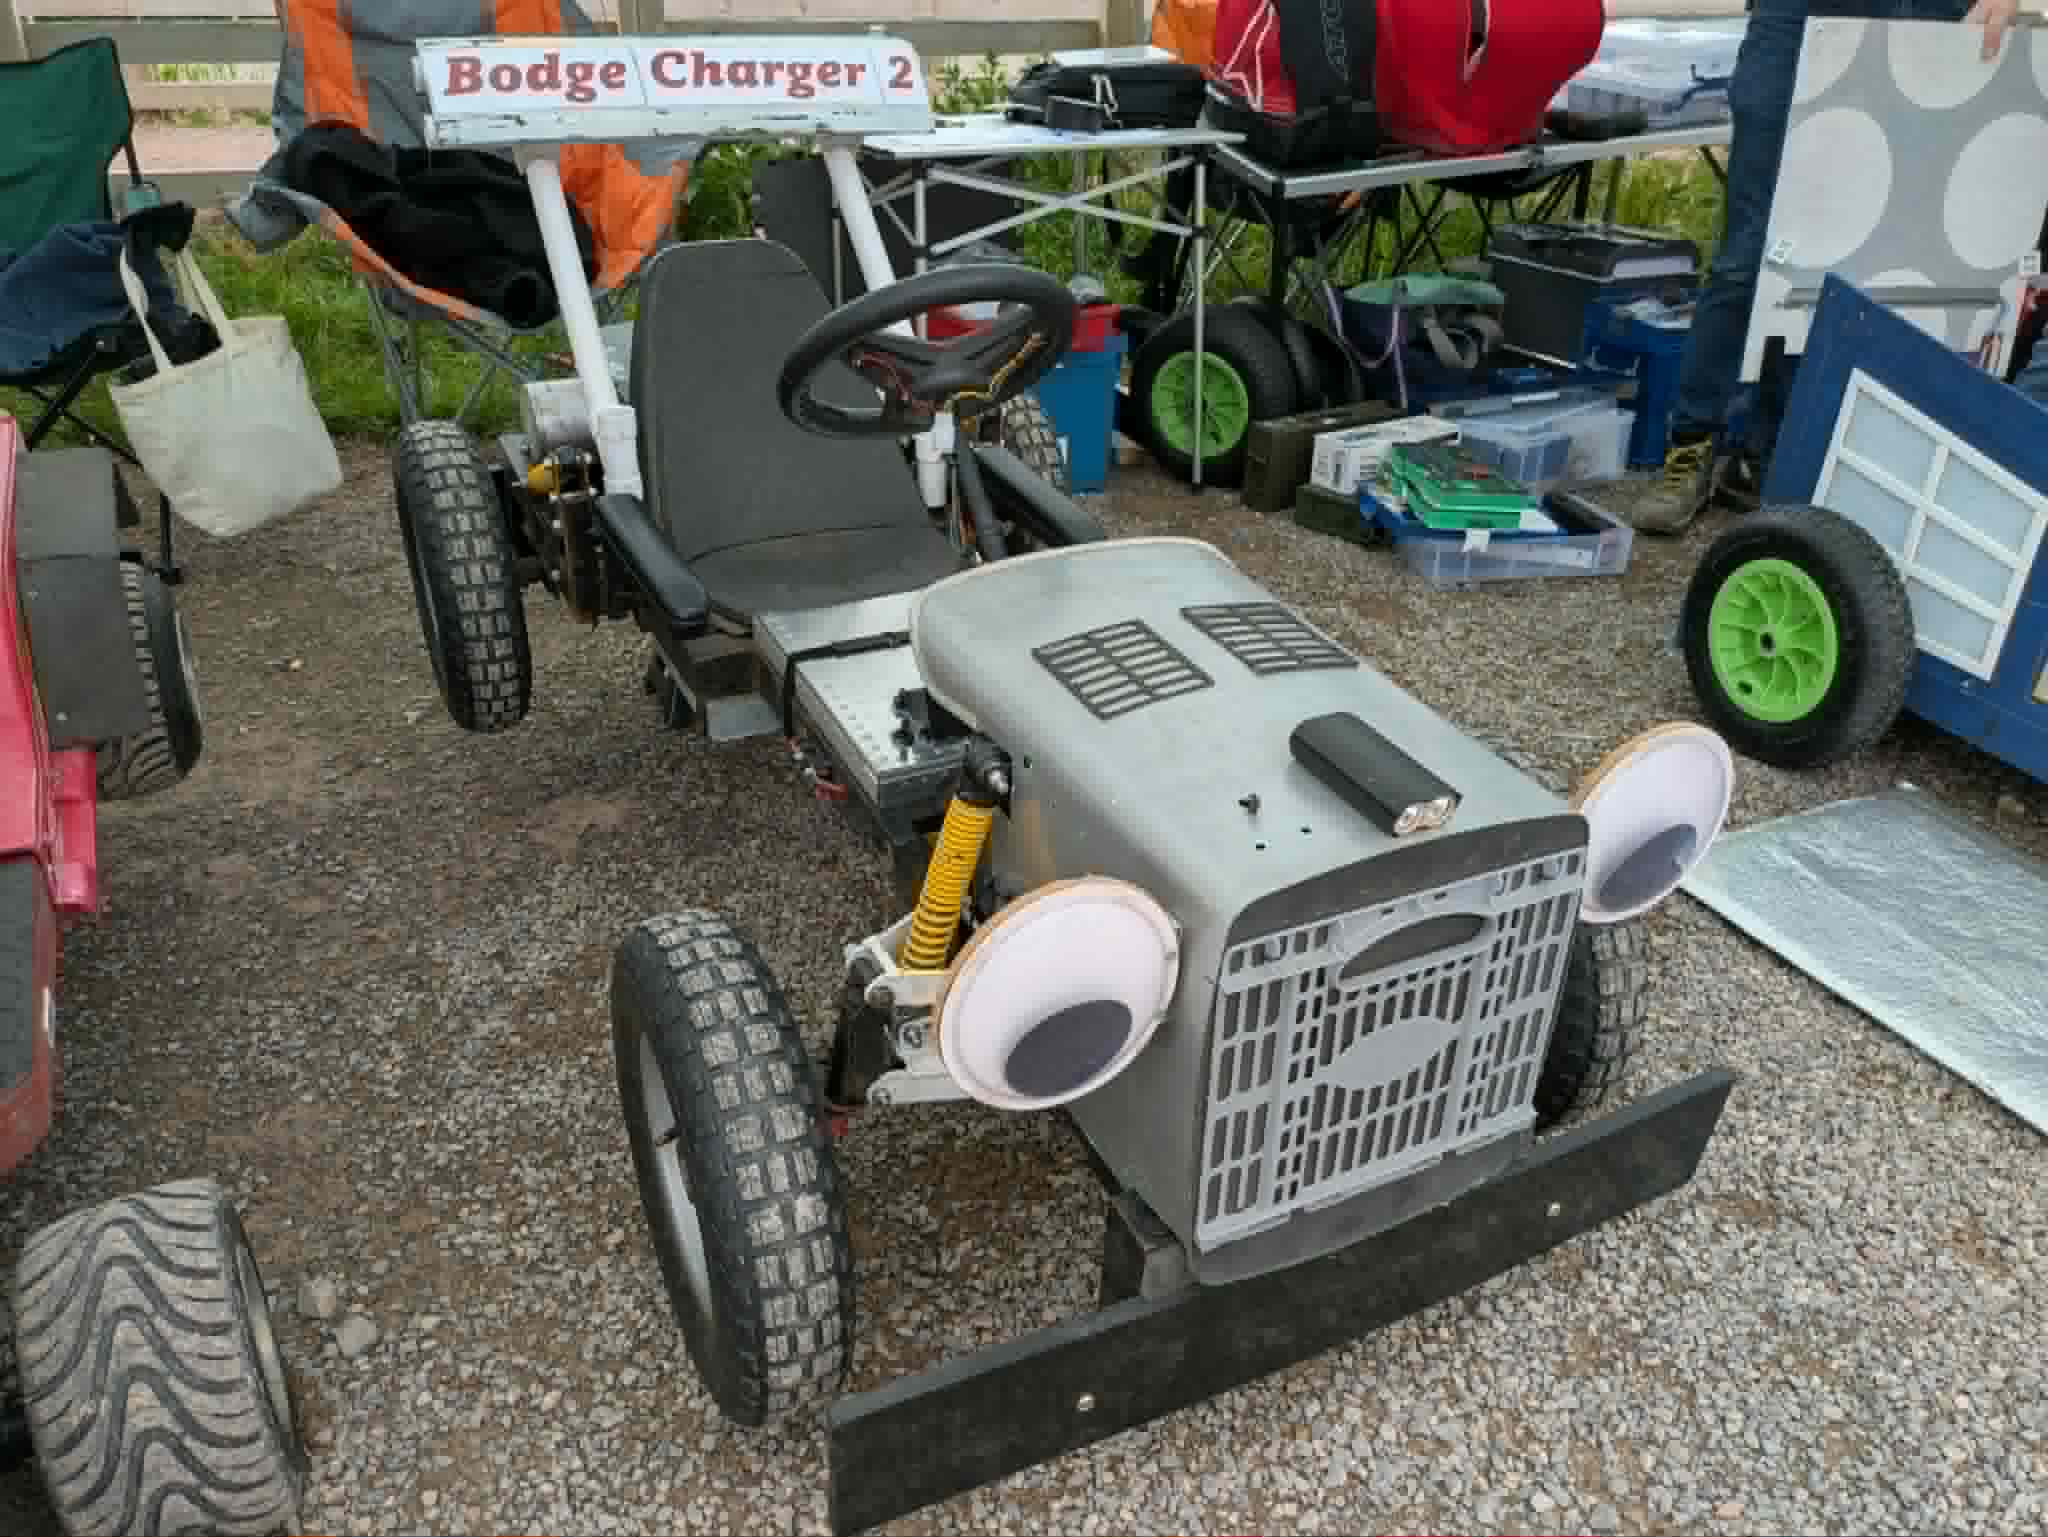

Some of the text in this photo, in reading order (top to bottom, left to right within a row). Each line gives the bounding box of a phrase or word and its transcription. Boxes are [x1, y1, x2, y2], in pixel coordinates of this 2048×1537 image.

[445, 50, 913, 102] Bodge Charger 2
